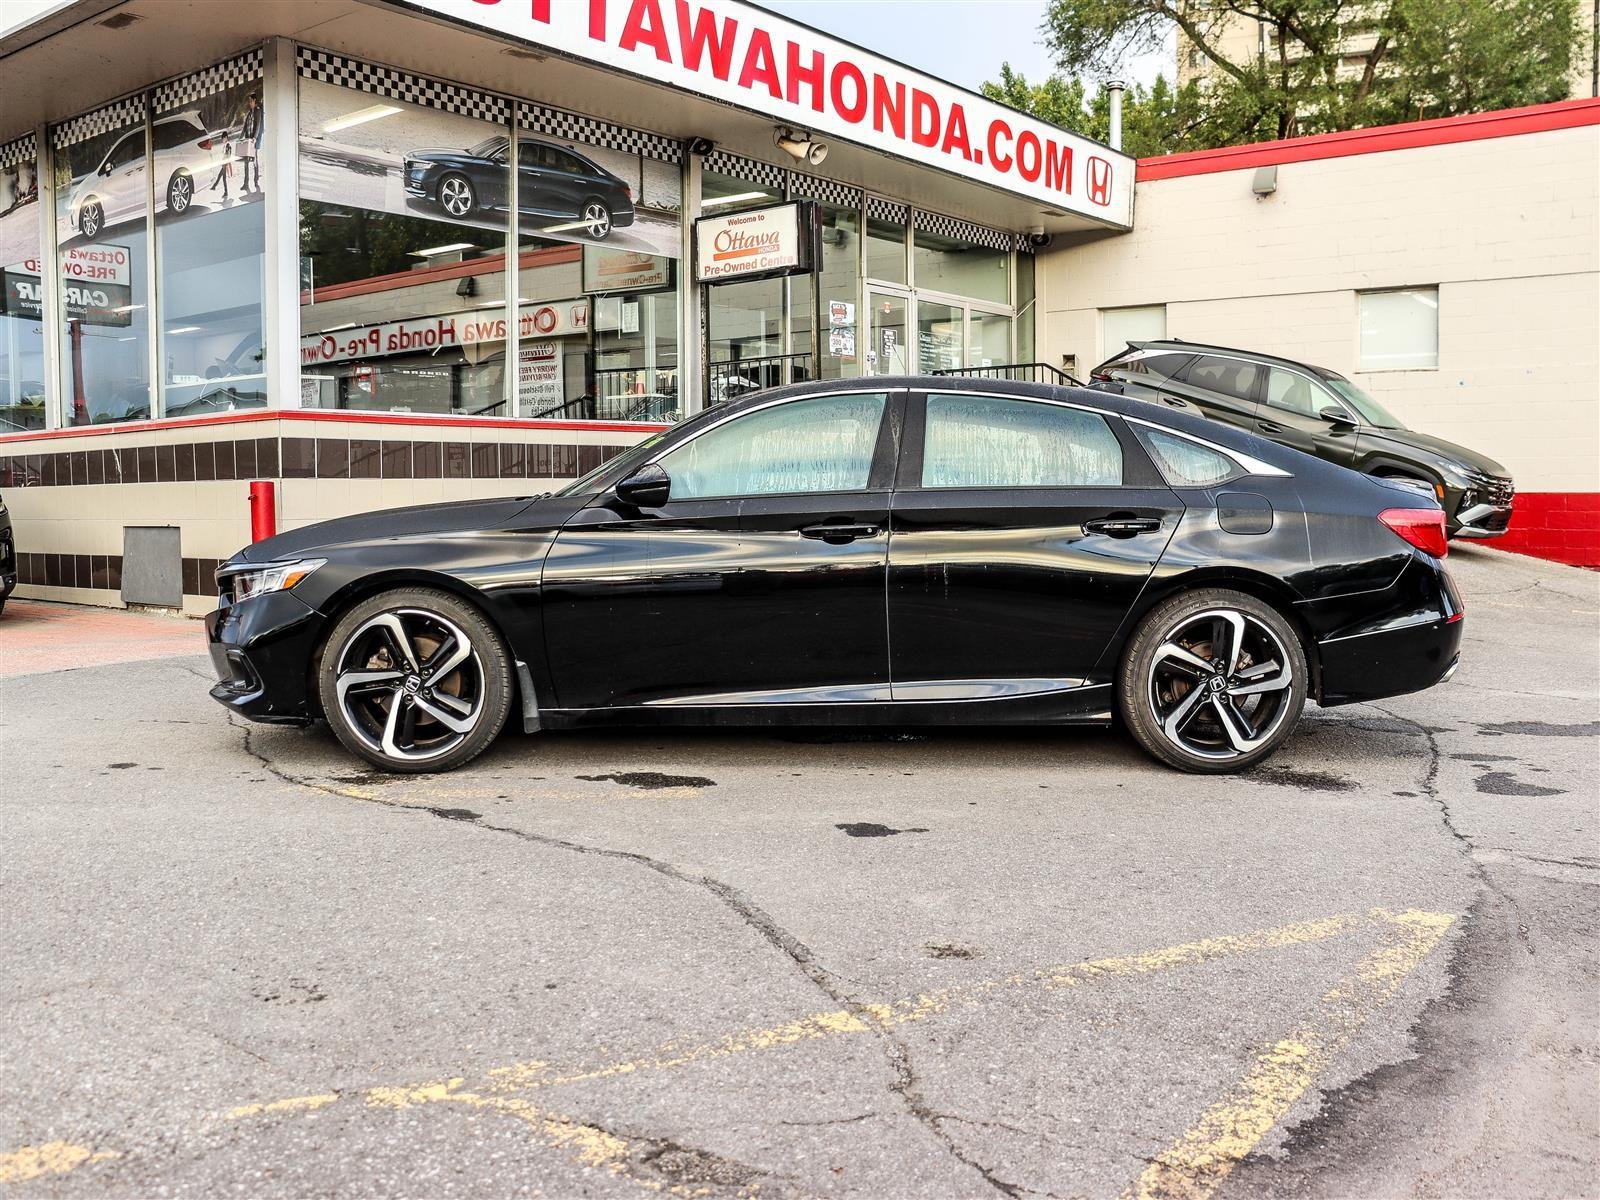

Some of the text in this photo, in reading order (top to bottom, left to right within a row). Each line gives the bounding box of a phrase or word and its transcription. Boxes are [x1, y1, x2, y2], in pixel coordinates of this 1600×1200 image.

[472, 0, 1073, 195] AWAHONDA.COM
[727, 215, 757, 226] Welcome
[714, 229, 780, 252] Ottawa
[704, 255, 794, 276] Pre-Owned Centre
